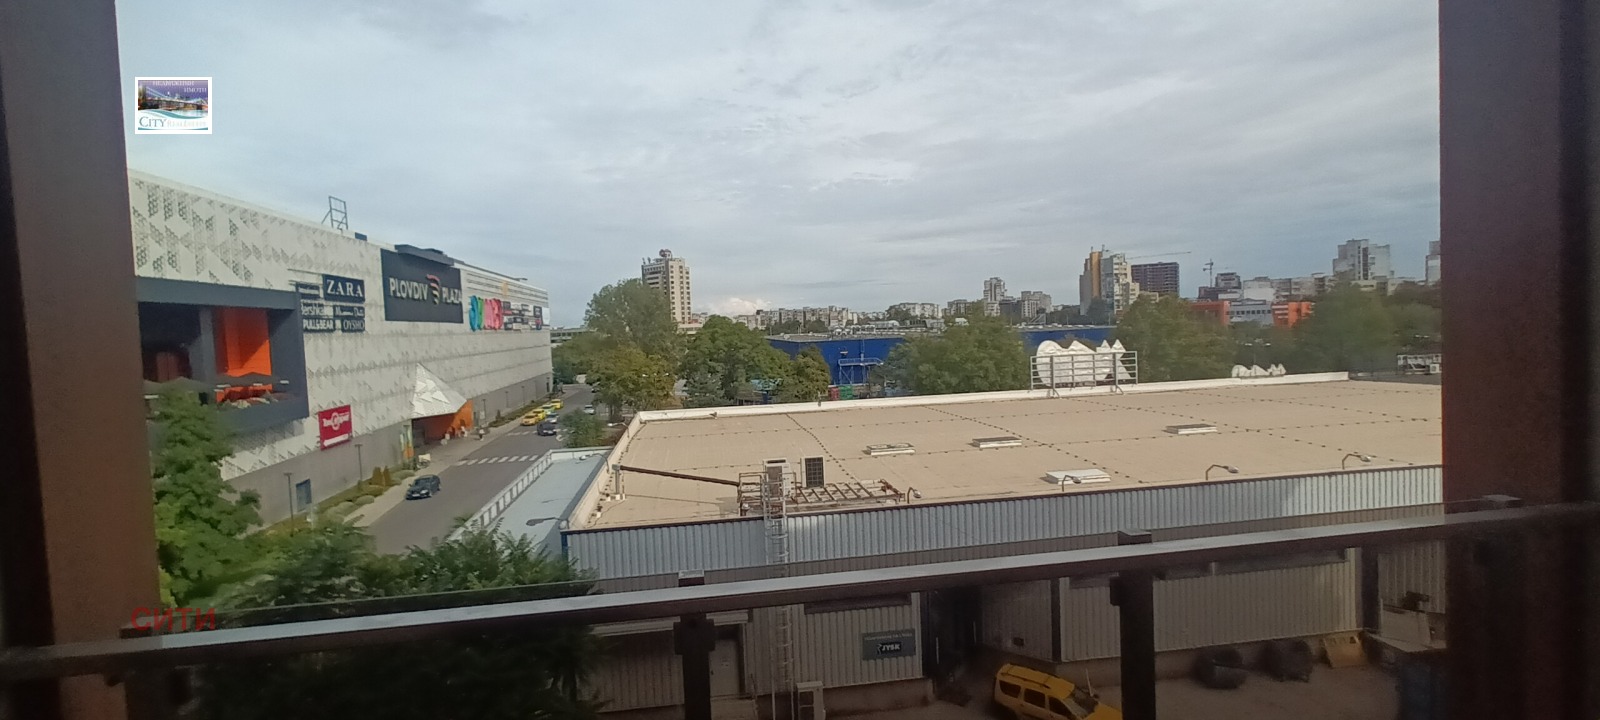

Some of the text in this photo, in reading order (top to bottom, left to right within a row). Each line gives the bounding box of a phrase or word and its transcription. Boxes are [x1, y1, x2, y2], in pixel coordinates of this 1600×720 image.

[326, 279, 364, 298] ZARA
[389, 277, 428, 301] PLOVDIV
[343, 319, 365, 330] OYSHO
[881, 643, 901, 651] JYSK
